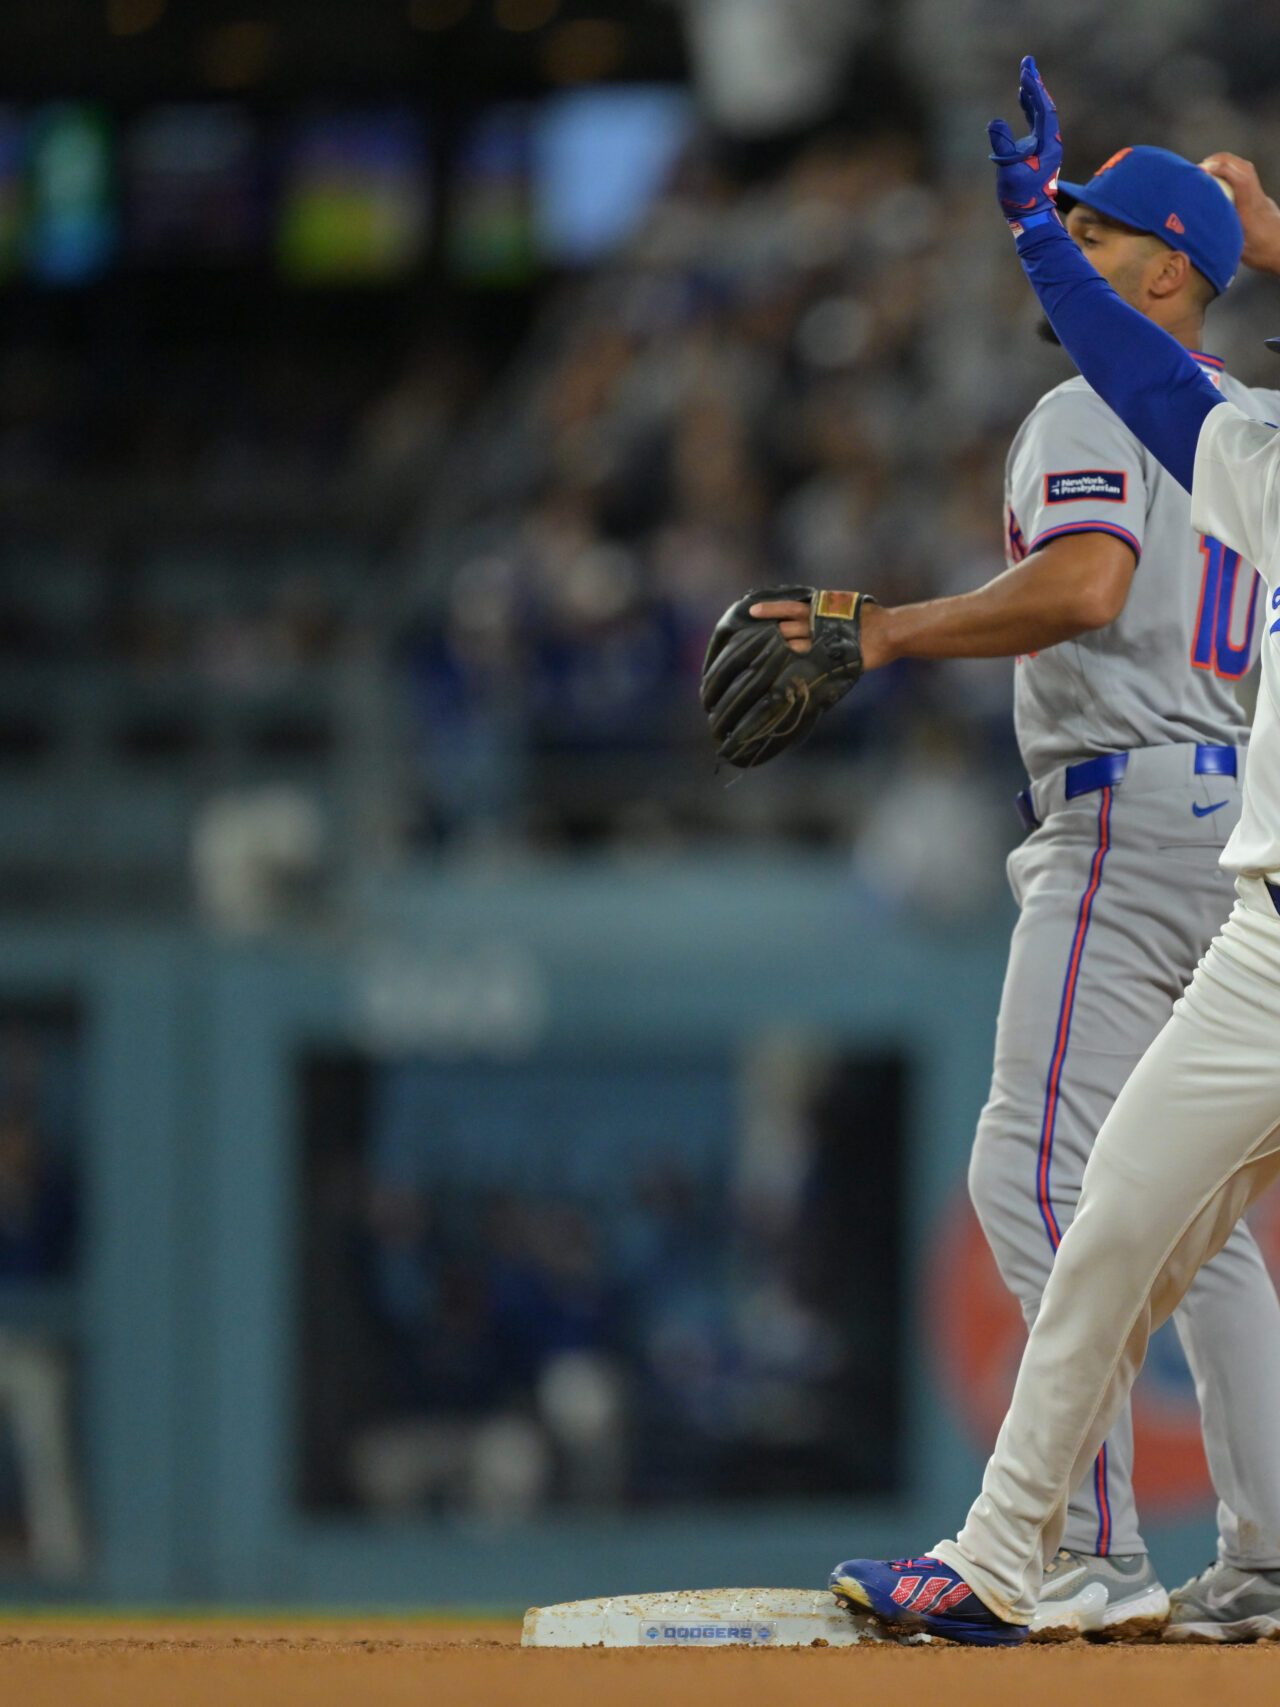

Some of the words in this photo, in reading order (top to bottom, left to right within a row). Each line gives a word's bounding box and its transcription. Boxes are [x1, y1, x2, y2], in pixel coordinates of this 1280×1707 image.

[1061, 484, 1120, 494] Presbyterian
[1190, 534, 1261, 681] 10
[664, 1627, 752, 1639] DODGERS
